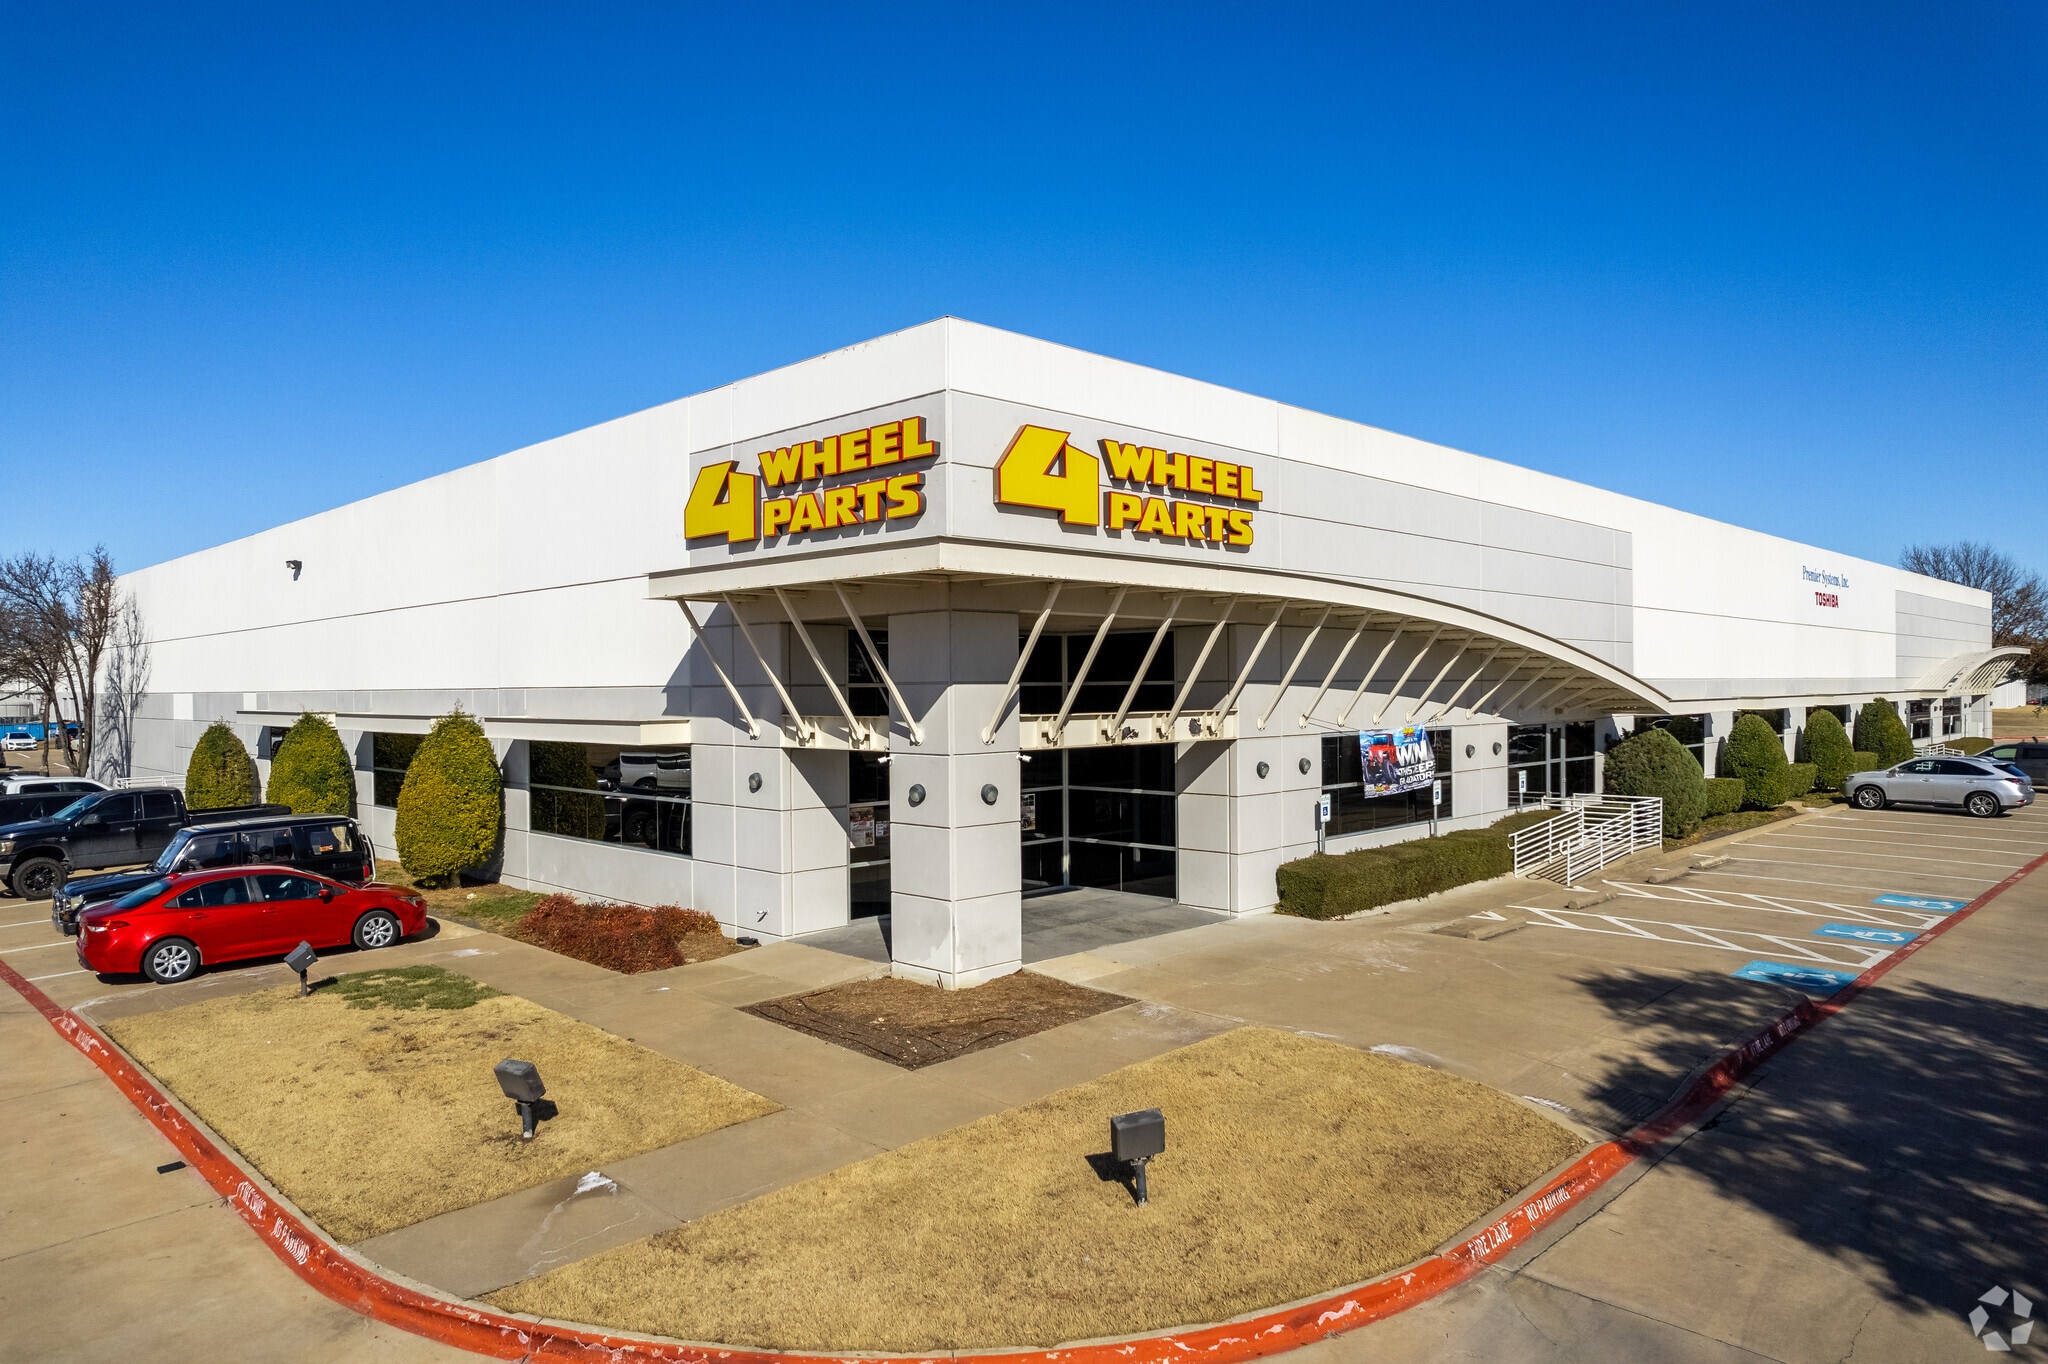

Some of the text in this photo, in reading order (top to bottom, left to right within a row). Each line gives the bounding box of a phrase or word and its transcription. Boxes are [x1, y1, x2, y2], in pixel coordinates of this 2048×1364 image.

[684, 416, 938, 543] 4 WHEEL
[995, 423, 1263, 526] 4 WHEEL
[763, 472, 924, 537] PARTS
[1104, 491, 1254, 545] PARTS
[1802, 565, 1821, 583] Premier
[1815, 591, 1839, 608] TOSHIBA
[1524, 1185, 1571, 1222] NO PARKING
[1467, 1221, 1512, 1261] FIRE LANE
